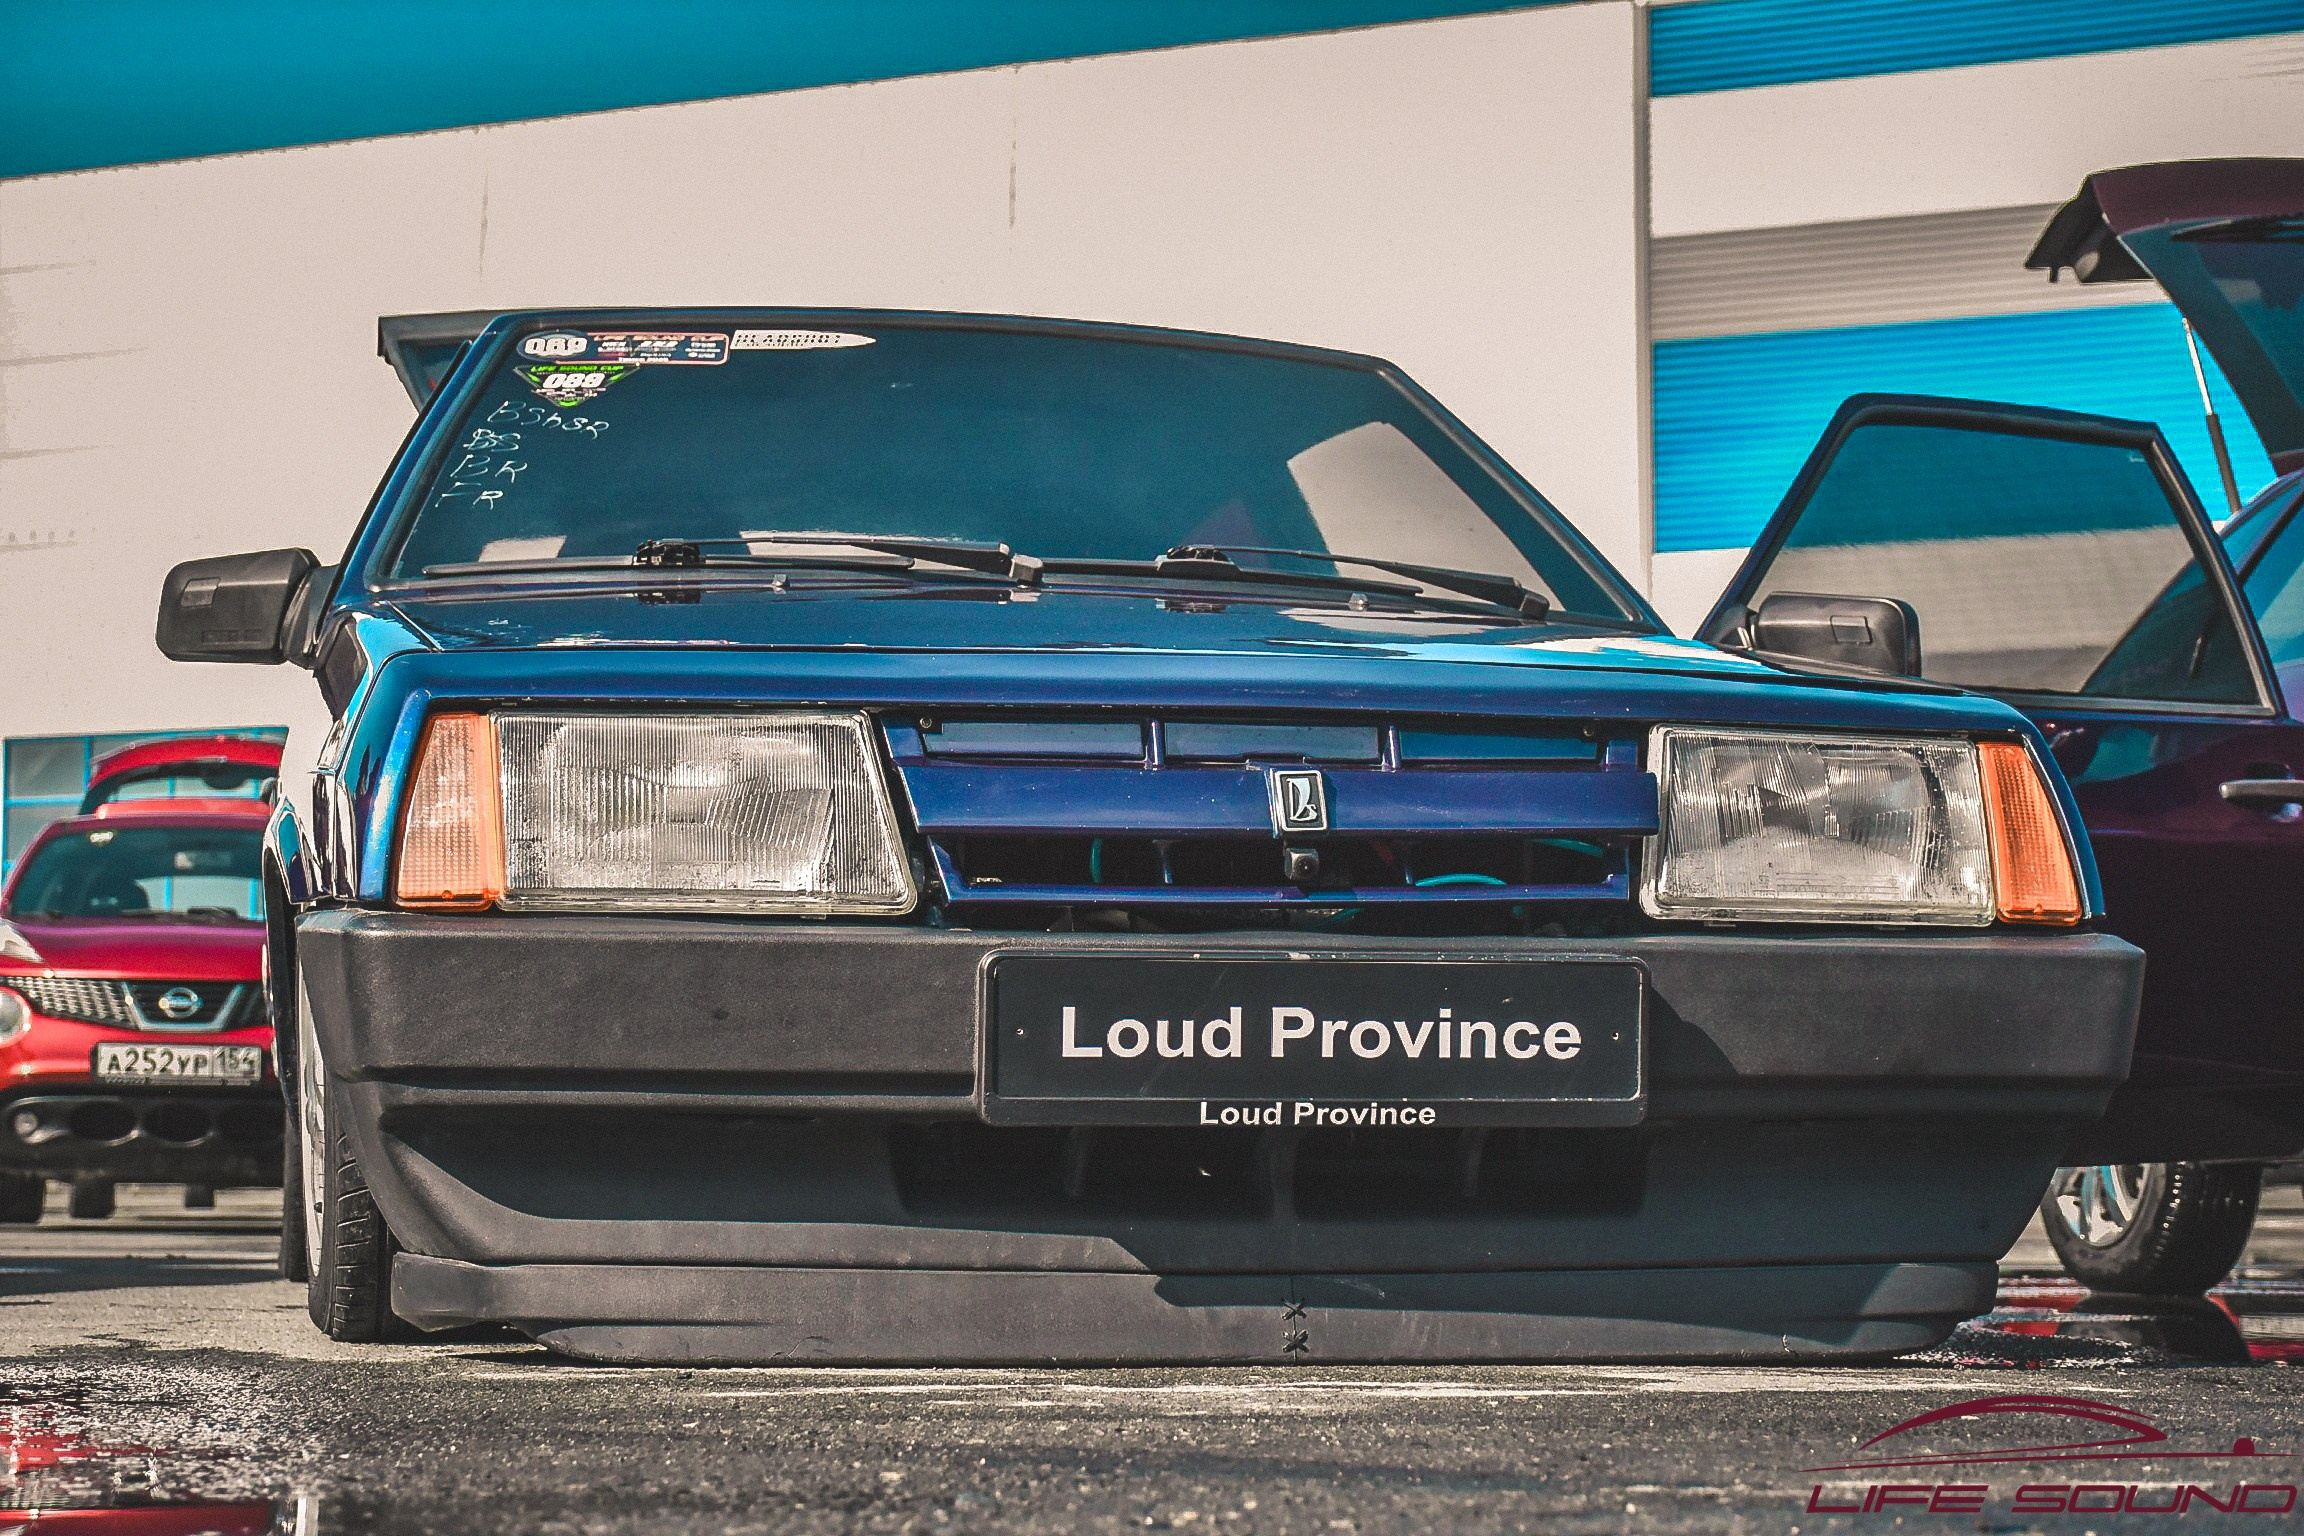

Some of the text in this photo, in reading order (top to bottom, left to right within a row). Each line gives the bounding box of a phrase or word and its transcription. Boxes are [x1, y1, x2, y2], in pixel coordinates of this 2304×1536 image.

[1061, 1006, 1583, 1060] Loud Province
[1200, 1101, 1437, 1127] Loud Province
